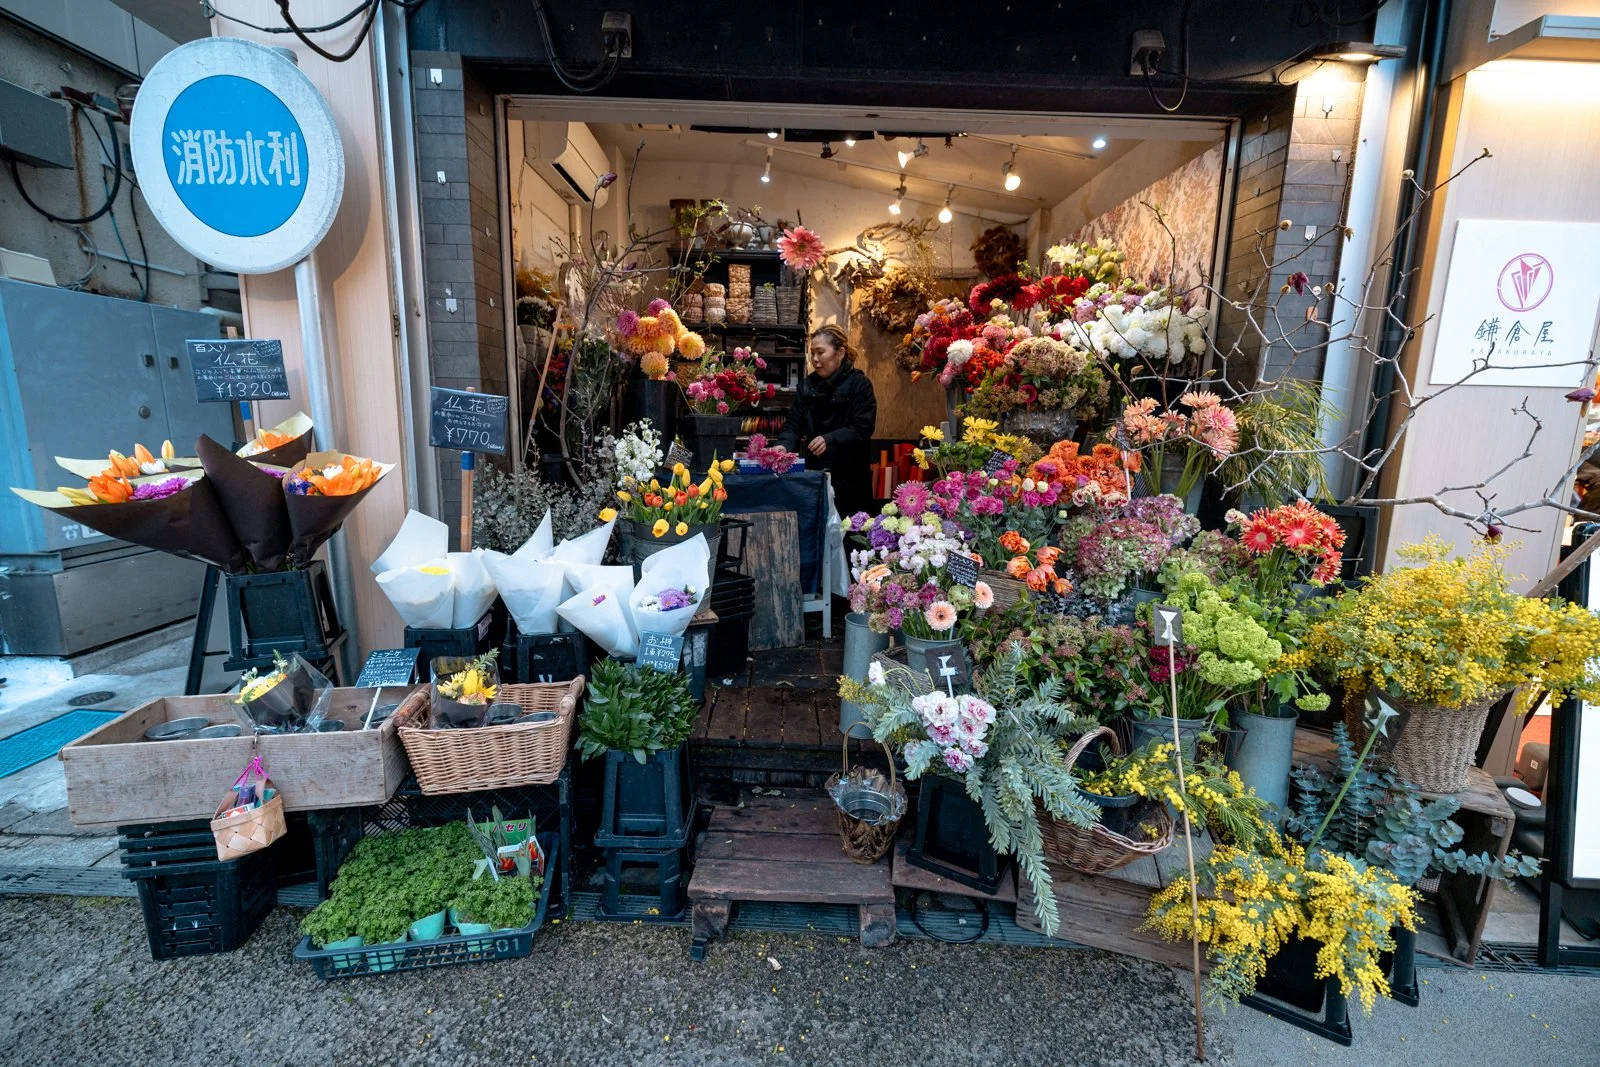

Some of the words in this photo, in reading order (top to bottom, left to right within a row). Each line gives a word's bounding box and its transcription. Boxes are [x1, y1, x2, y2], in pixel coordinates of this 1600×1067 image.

[171, 129, 301, 187] 消防水利
[1474, 317, 1554, 348] 鎌倉屋
[214, 352, 259, 366] 仏花
[444, 395, 486, 414] 仏花
[444, 425, 490, 445] ¥770
[496, 939, 520, 952] 01
